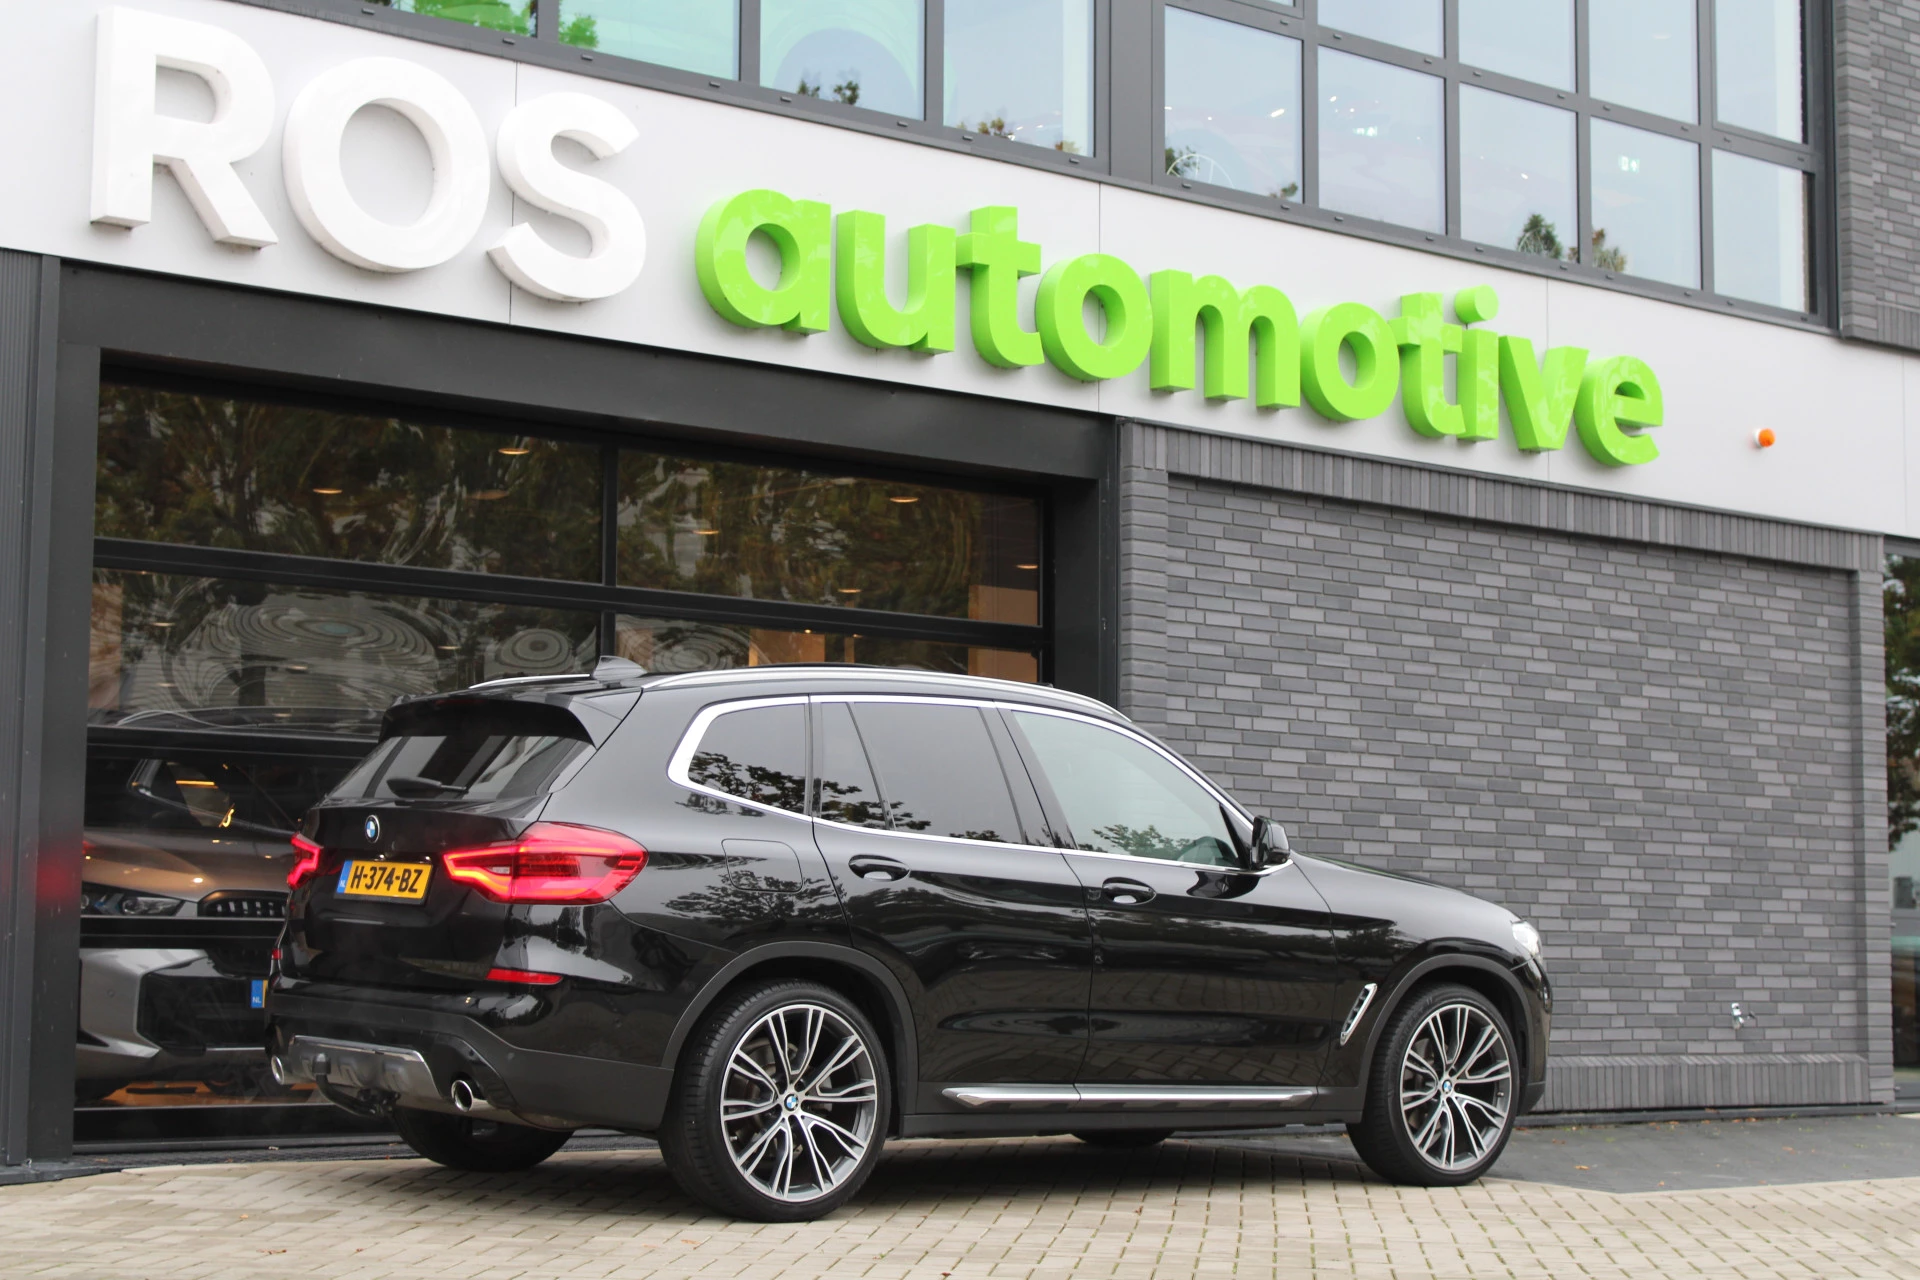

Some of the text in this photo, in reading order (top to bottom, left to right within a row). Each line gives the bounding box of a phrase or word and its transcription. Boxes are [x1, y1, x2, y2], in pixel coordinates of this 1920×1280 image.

[90, 6, 1664, 467] ROS automotive
[350, 865, 424, 894] H-374-BZ
[252, 996, 262, 1004] NL
